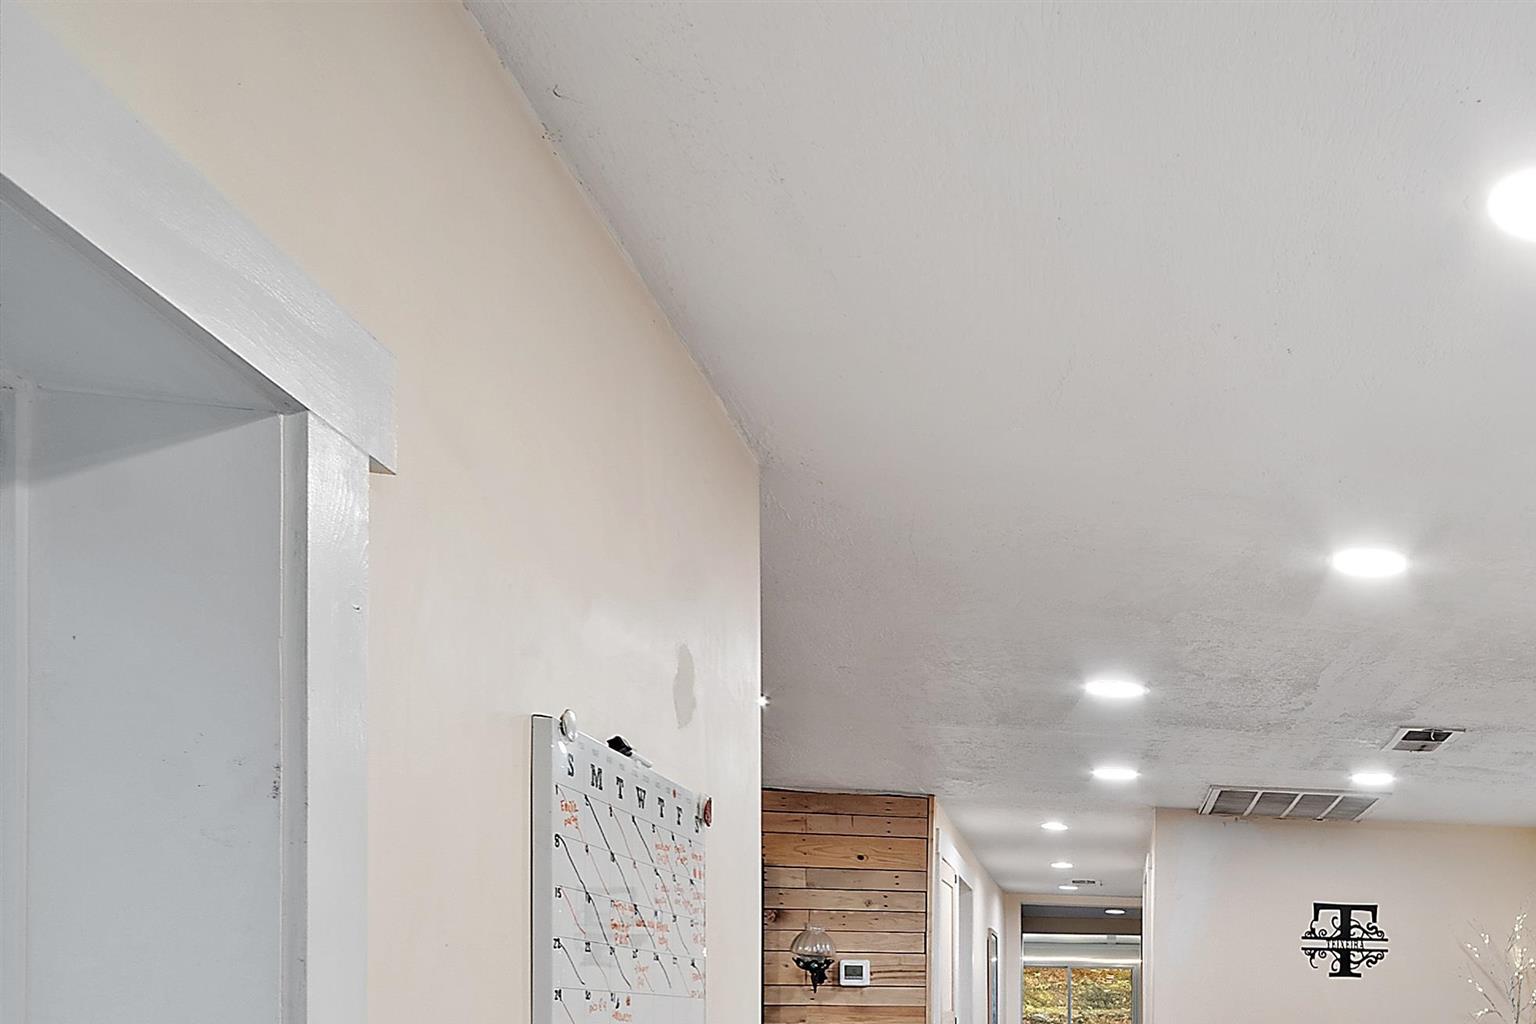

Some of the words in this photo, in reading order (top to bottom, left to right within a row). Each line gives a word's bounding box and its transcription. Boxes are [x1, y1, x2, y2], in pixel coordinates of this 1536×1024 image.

[567, 753, 574, 777] S
[590, 763, 603, 791] M
[615, 776, 625, 800] T
[635, 786, 648, 809] W
[657, 797, 666, 818] T
[676, 806, 683, 826] F
[554, 887, 562, 898] 15
